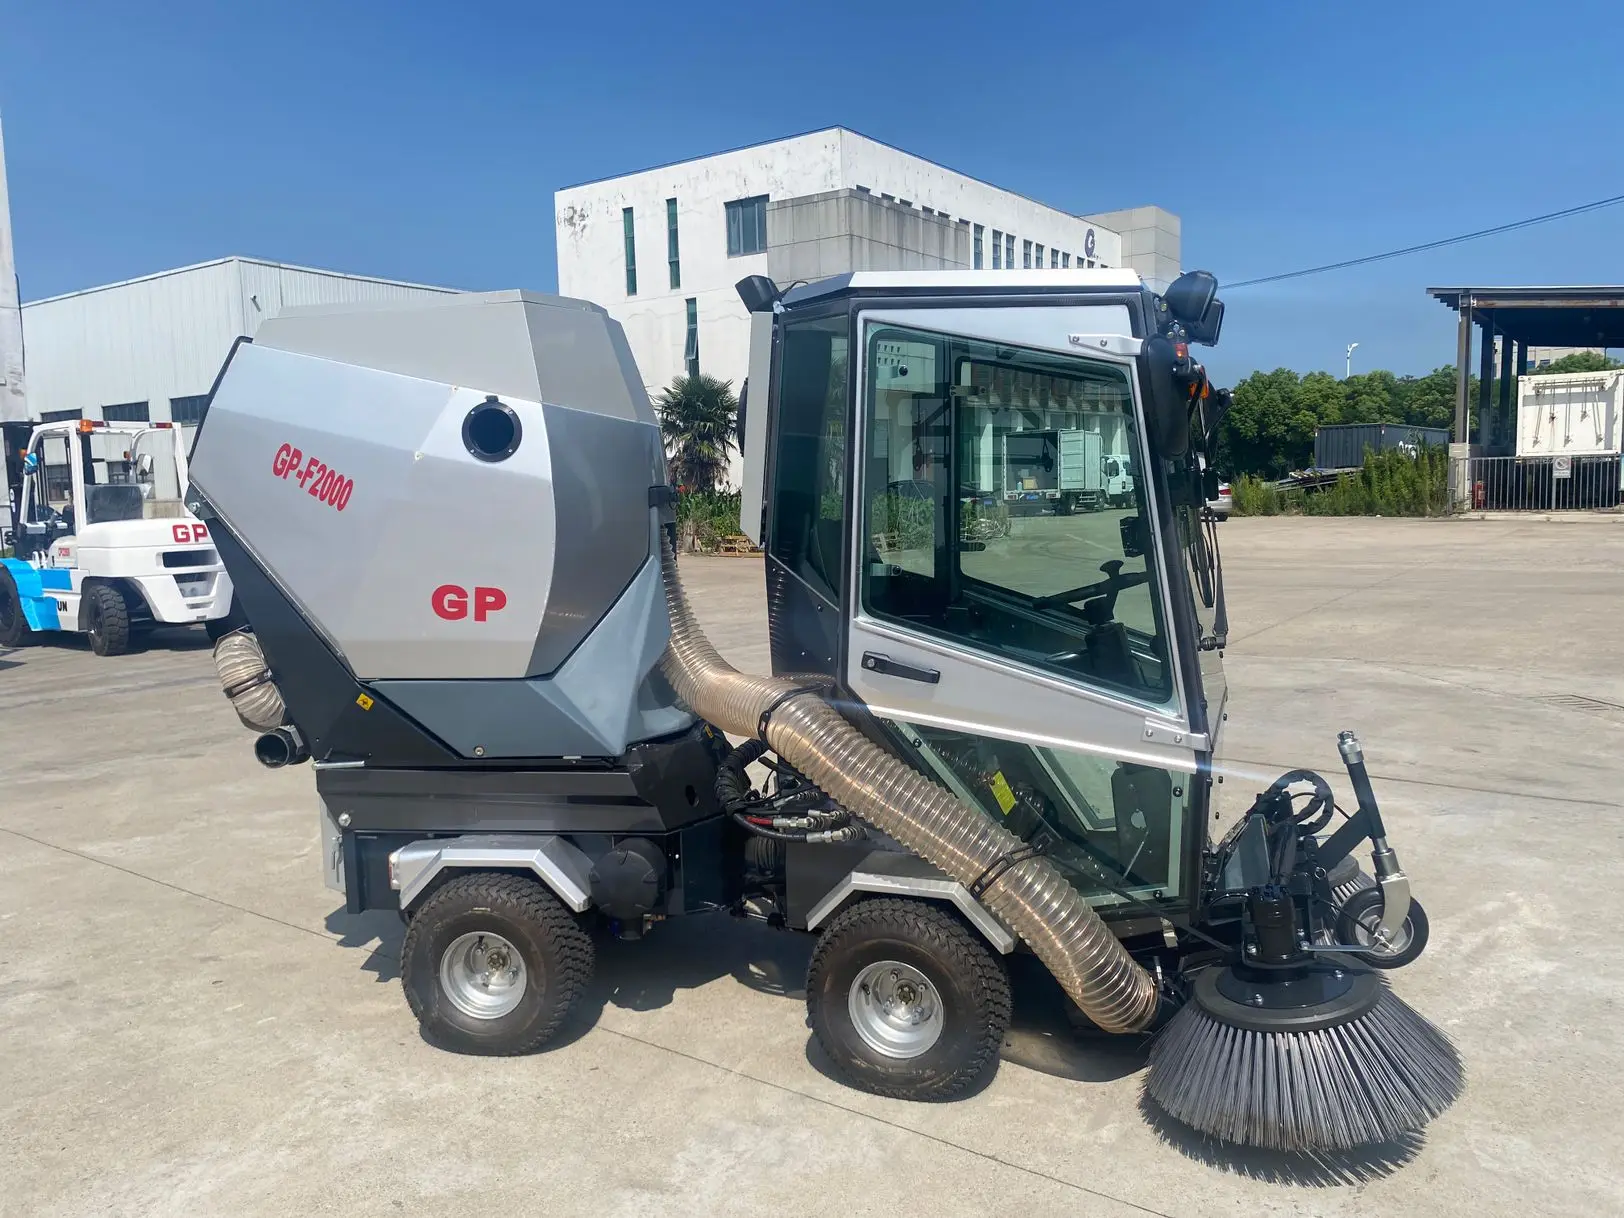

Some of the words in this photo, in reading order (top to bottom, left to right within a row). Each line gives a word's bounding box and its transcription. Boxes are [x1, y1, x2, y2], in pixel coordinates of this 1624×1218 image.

[272, 442, 354, 512] GP-F2000
[172, 524, 208, 543] GP
[431, 584, 507, 622] GP
